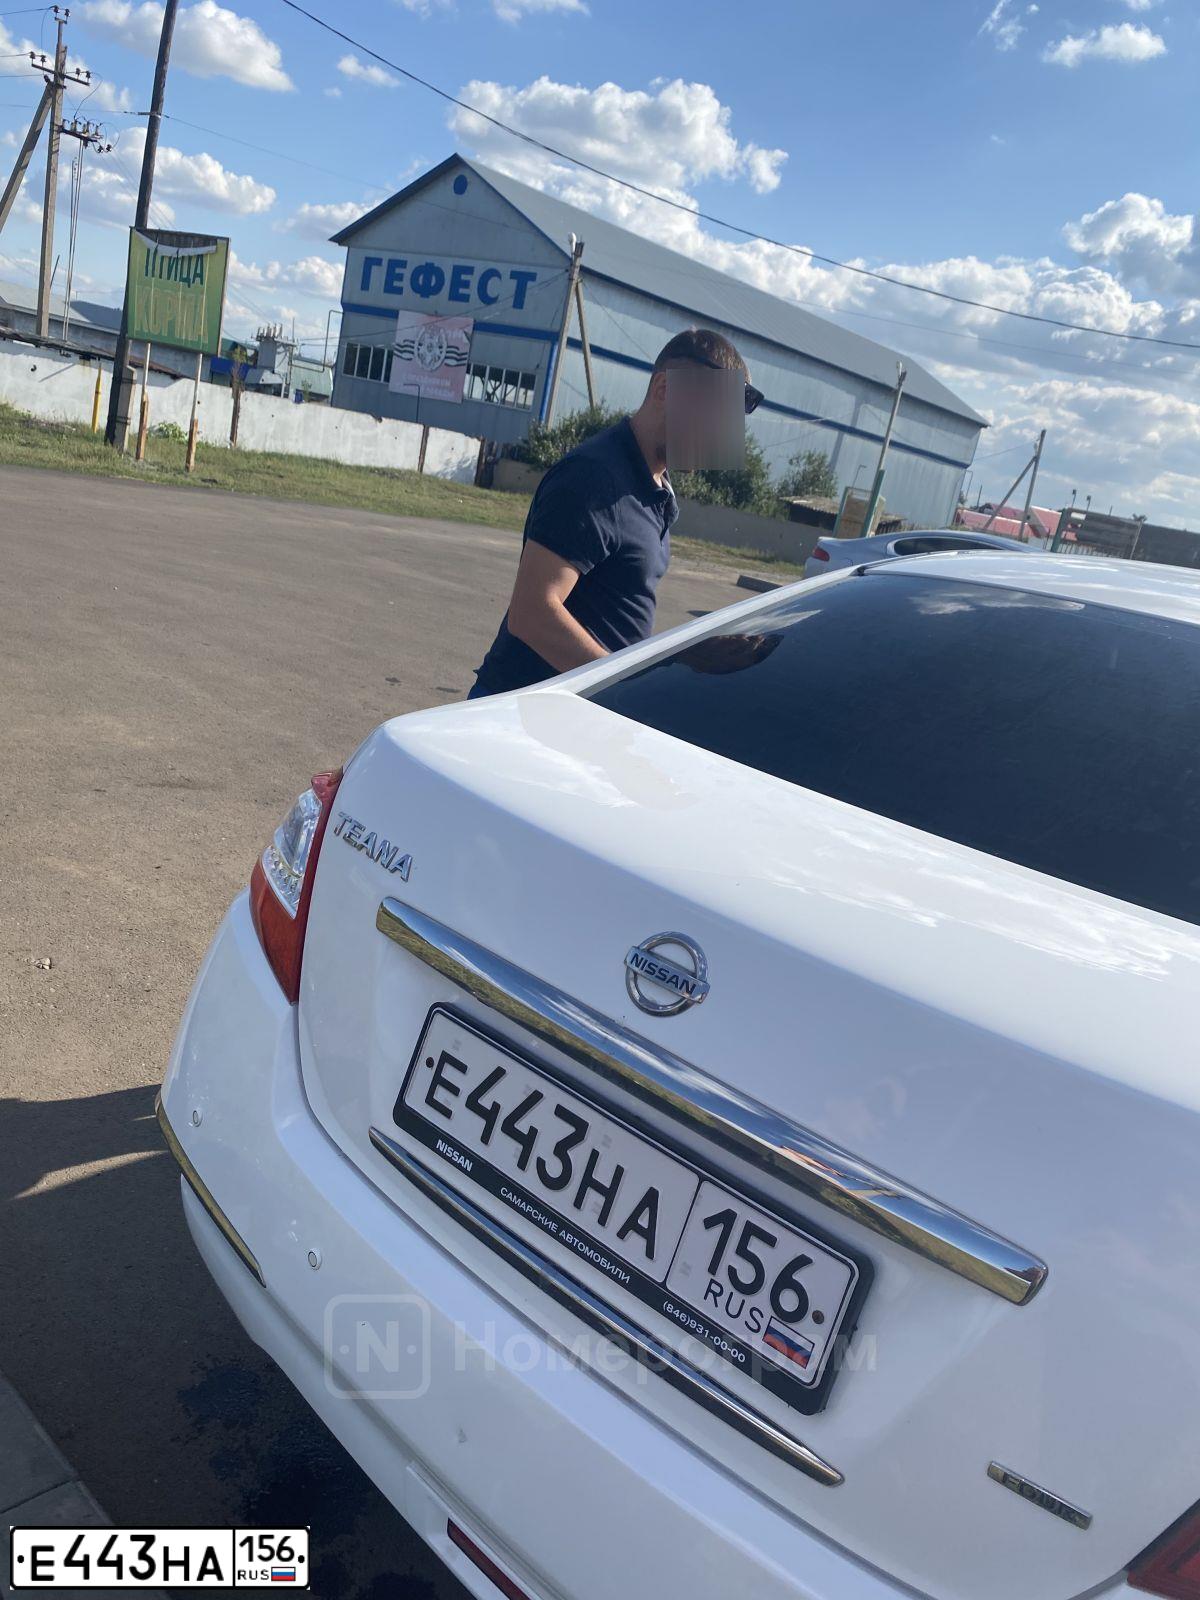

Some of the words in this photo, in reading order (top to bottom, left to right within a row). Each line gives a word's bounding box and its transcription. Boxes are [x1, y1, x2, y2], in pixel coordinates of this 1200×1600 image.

[360, 256, 538, 310] ГЕФЕСТ
[333, 811, 415, 883] TEANA
[630, 952, 697, 995] NISSAN
[435, 1138, 474, 1173] NISSAN
[500, 1186, 559, 1233] САМАРСКИЕ
[558, 1229, 631, 1285] АВТОМОБИЛИ
[703, 1208, 814, 1324] 156
[662, 1300, 747, 1364] (846)931-00-00
[703, 1278, 764, 1334] RUS
